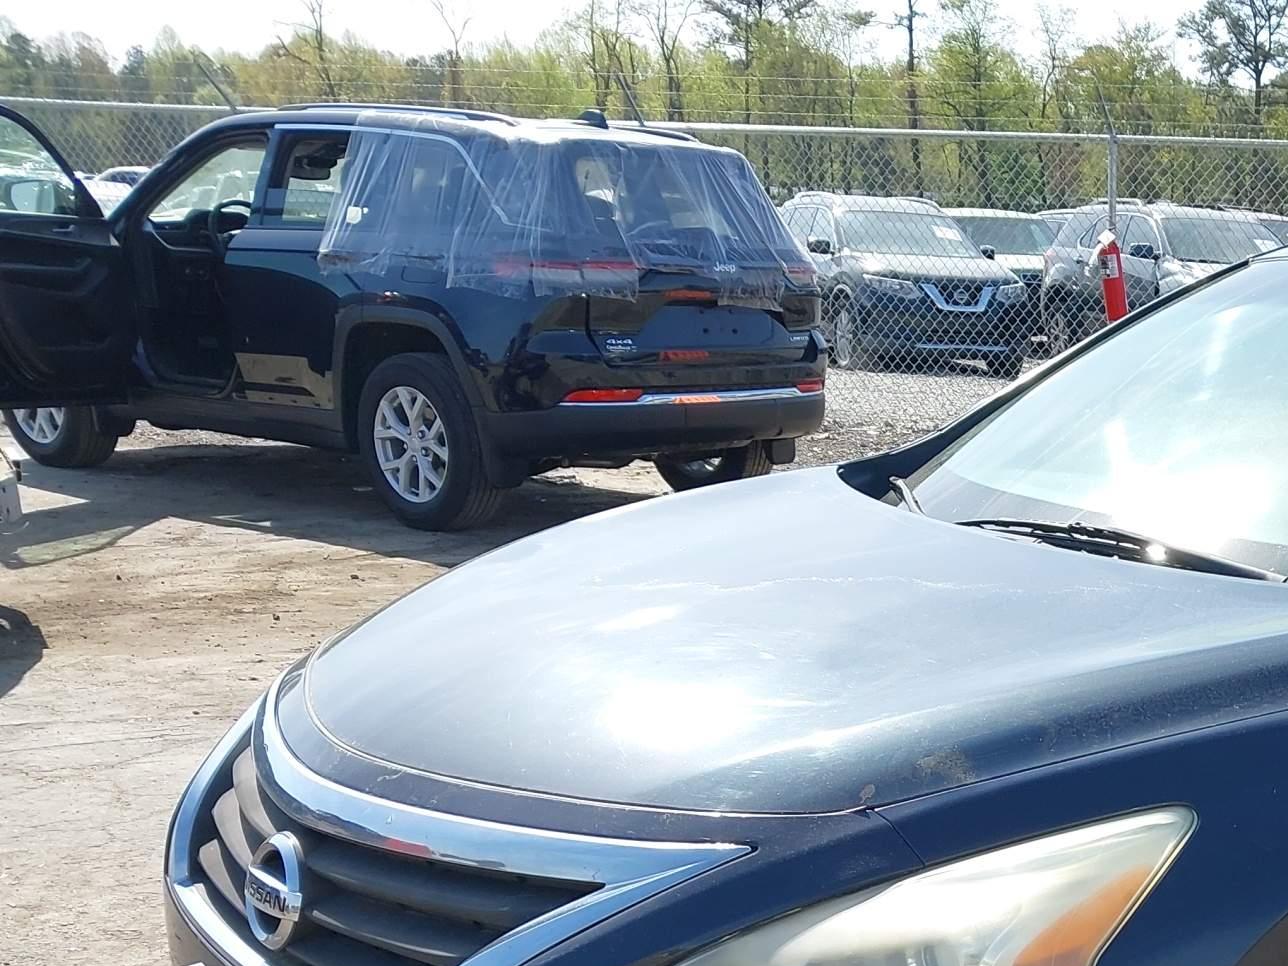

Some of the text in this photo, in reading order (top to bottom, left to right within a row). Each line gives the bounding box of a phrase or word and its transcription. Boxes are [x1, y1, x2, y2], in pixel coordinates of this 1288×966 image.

[713, 261, 736, 274] Jeep
[606, 338, 633, 346] 4x4
[246, 877, 287, 913] ISSAN
